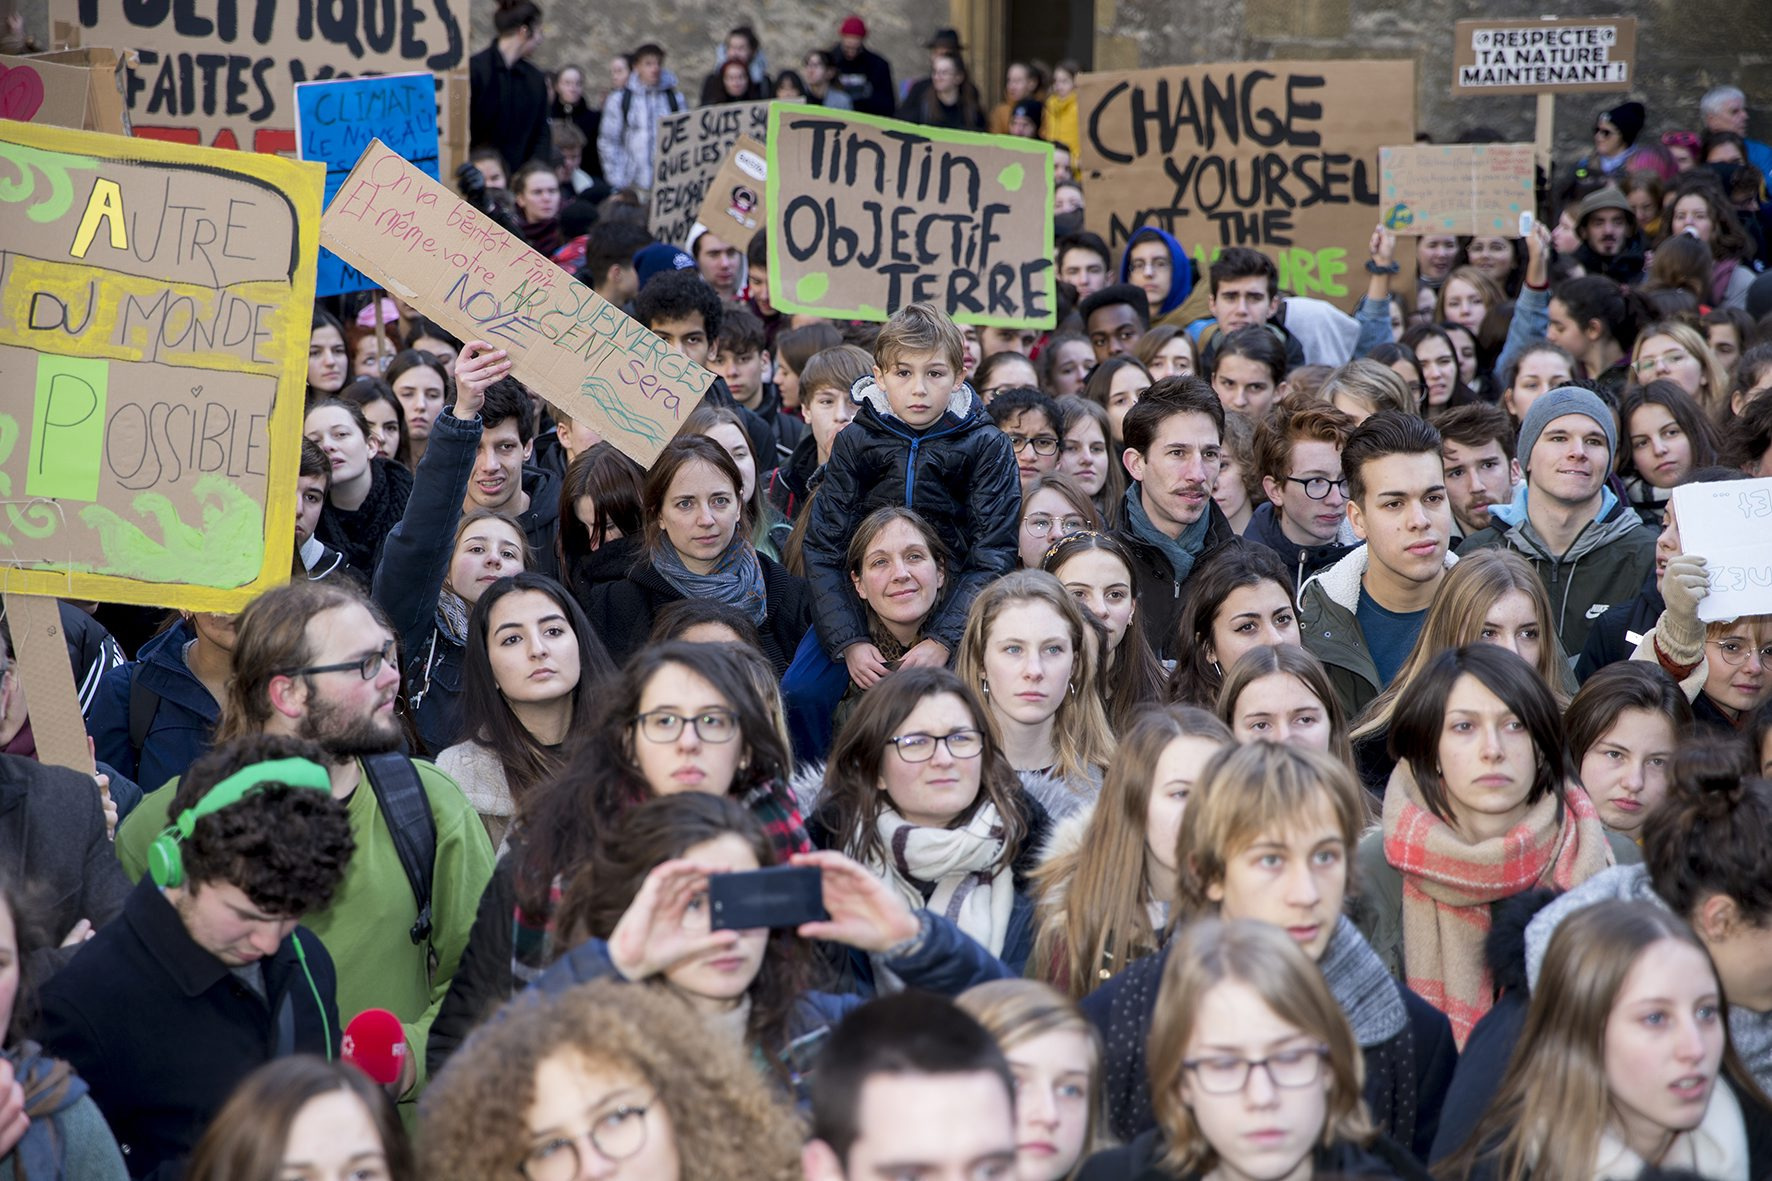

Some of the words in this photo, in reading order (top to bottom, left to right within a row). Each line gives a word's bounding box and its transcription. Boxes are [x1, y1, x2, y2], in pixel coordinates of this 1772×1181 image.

[78, 0, 464, 71] LIIQUES
[1481, 50, 1506, 65] TA
[1515, 47, 1603, 63] NATURE
[1494, 29, 1598, 47] RESPECTE
[126, 49, 275, 122] FAITES
[1463, 65, 1610, 83] MAINTENANT
[662, 115, 691, 154] JE
[699, 109, 742, 140] SUIS
[1089, 70, 1325, 163] CHANGE
[308, 129, 333, 157] LE
[371, 155, 412, 195] On
[657, 153, 691, 182] QUE
[1164, 153, 1380, 213] YOURSEL
[1207, 210, 1294, 246] THE
[877, 258, 1053, 319] TERRE
[28, 281, 94, 334] DU
[121, 290, 274, 364] MONDE
